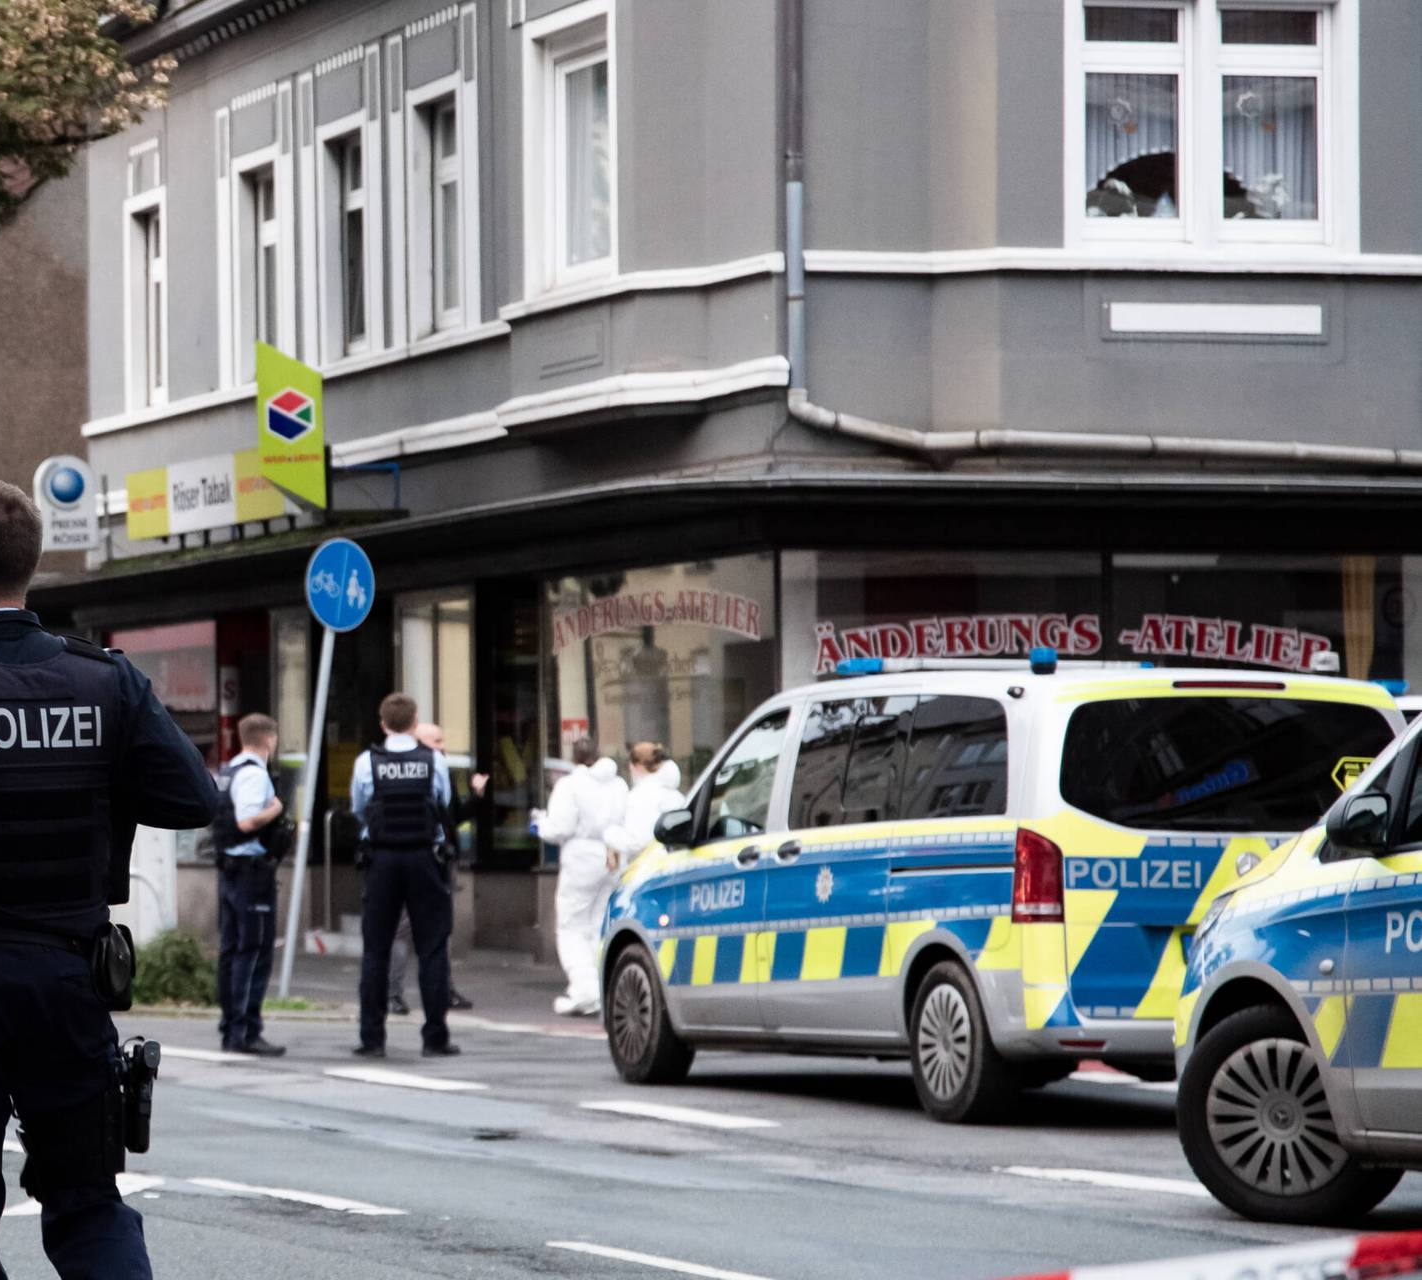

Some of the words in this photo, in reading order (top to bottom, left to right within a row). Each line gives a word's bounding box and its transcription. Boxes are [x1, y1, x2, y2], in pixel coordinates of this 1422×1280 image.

[201, 474, 233, 507] Tabak
[813, 614, 1103, 675] ÄNDERUNGS
[378, 761, 429, 780] POLIZEI
[1067, 859, 1202, 889] POLIZEI
[690, 879, 746, 912] POLIZEI
